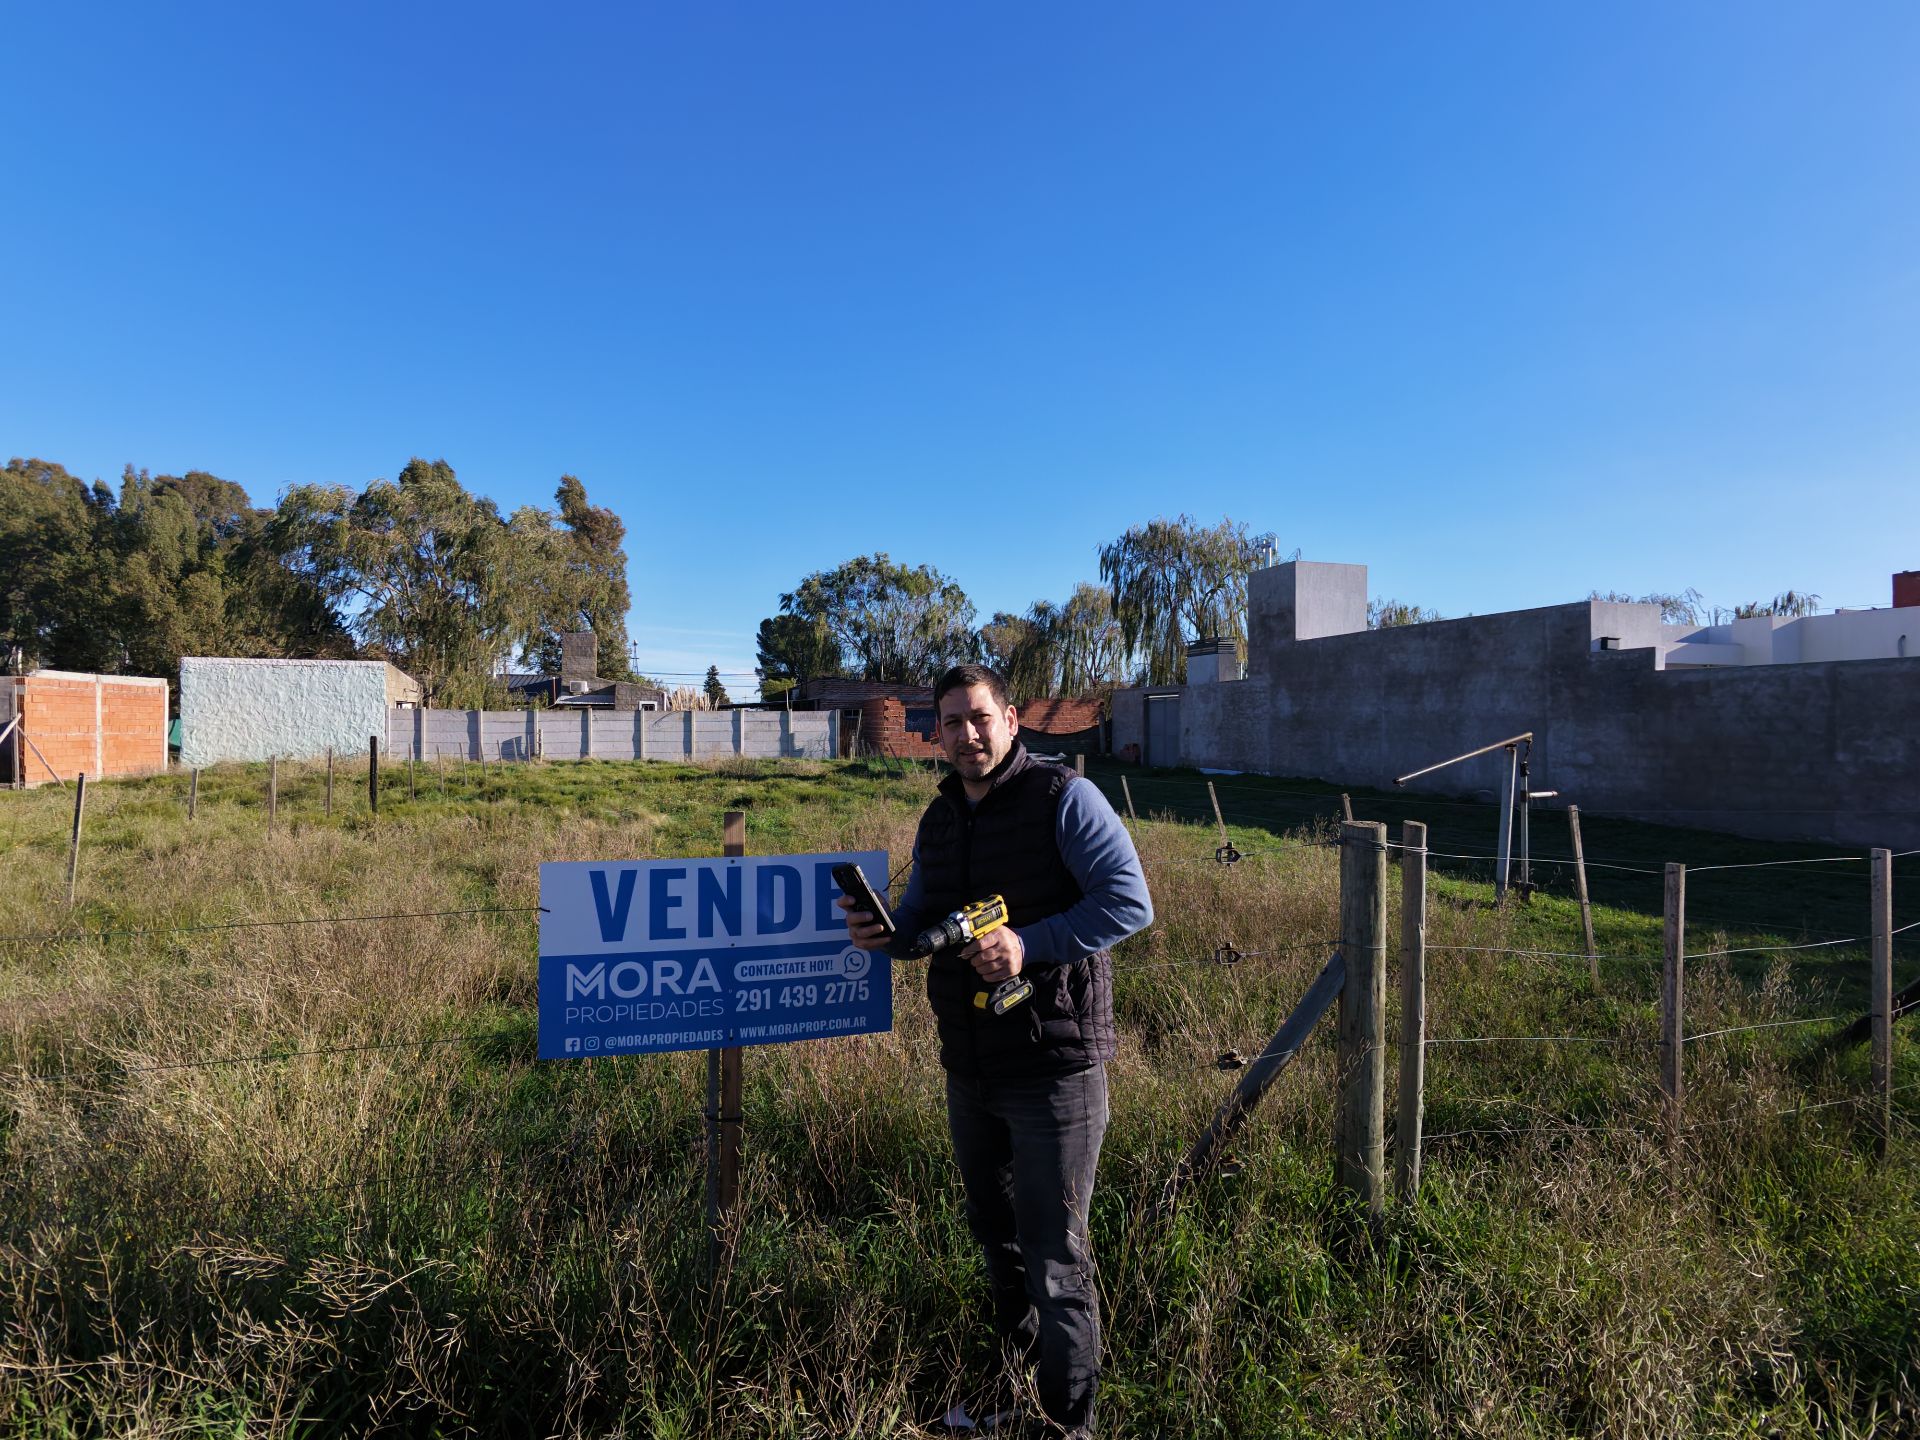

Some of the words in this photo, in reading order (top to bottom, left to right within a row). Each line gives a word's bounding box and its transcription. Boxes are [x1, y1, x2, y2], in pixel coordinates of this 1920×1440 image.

[589, 862, 851, 943] VENDE
[566, 957, 722, 1001] MORA
[740, 963, 806, 978] CONTACTATE
[809, 960, 833, 973] HOY!
[736, 988, 771, 1012] 291
[779, 984, 818, 1008] 439
[824, 979, 870, 1005] 2775
[566, 999, 724, 1025] PROPIEDADES
[604, 1029, 724, 1049] @MORAPROPIEDADES
[740, 1016, 867, 1039] WWW.MORAPROP.COM.AR
